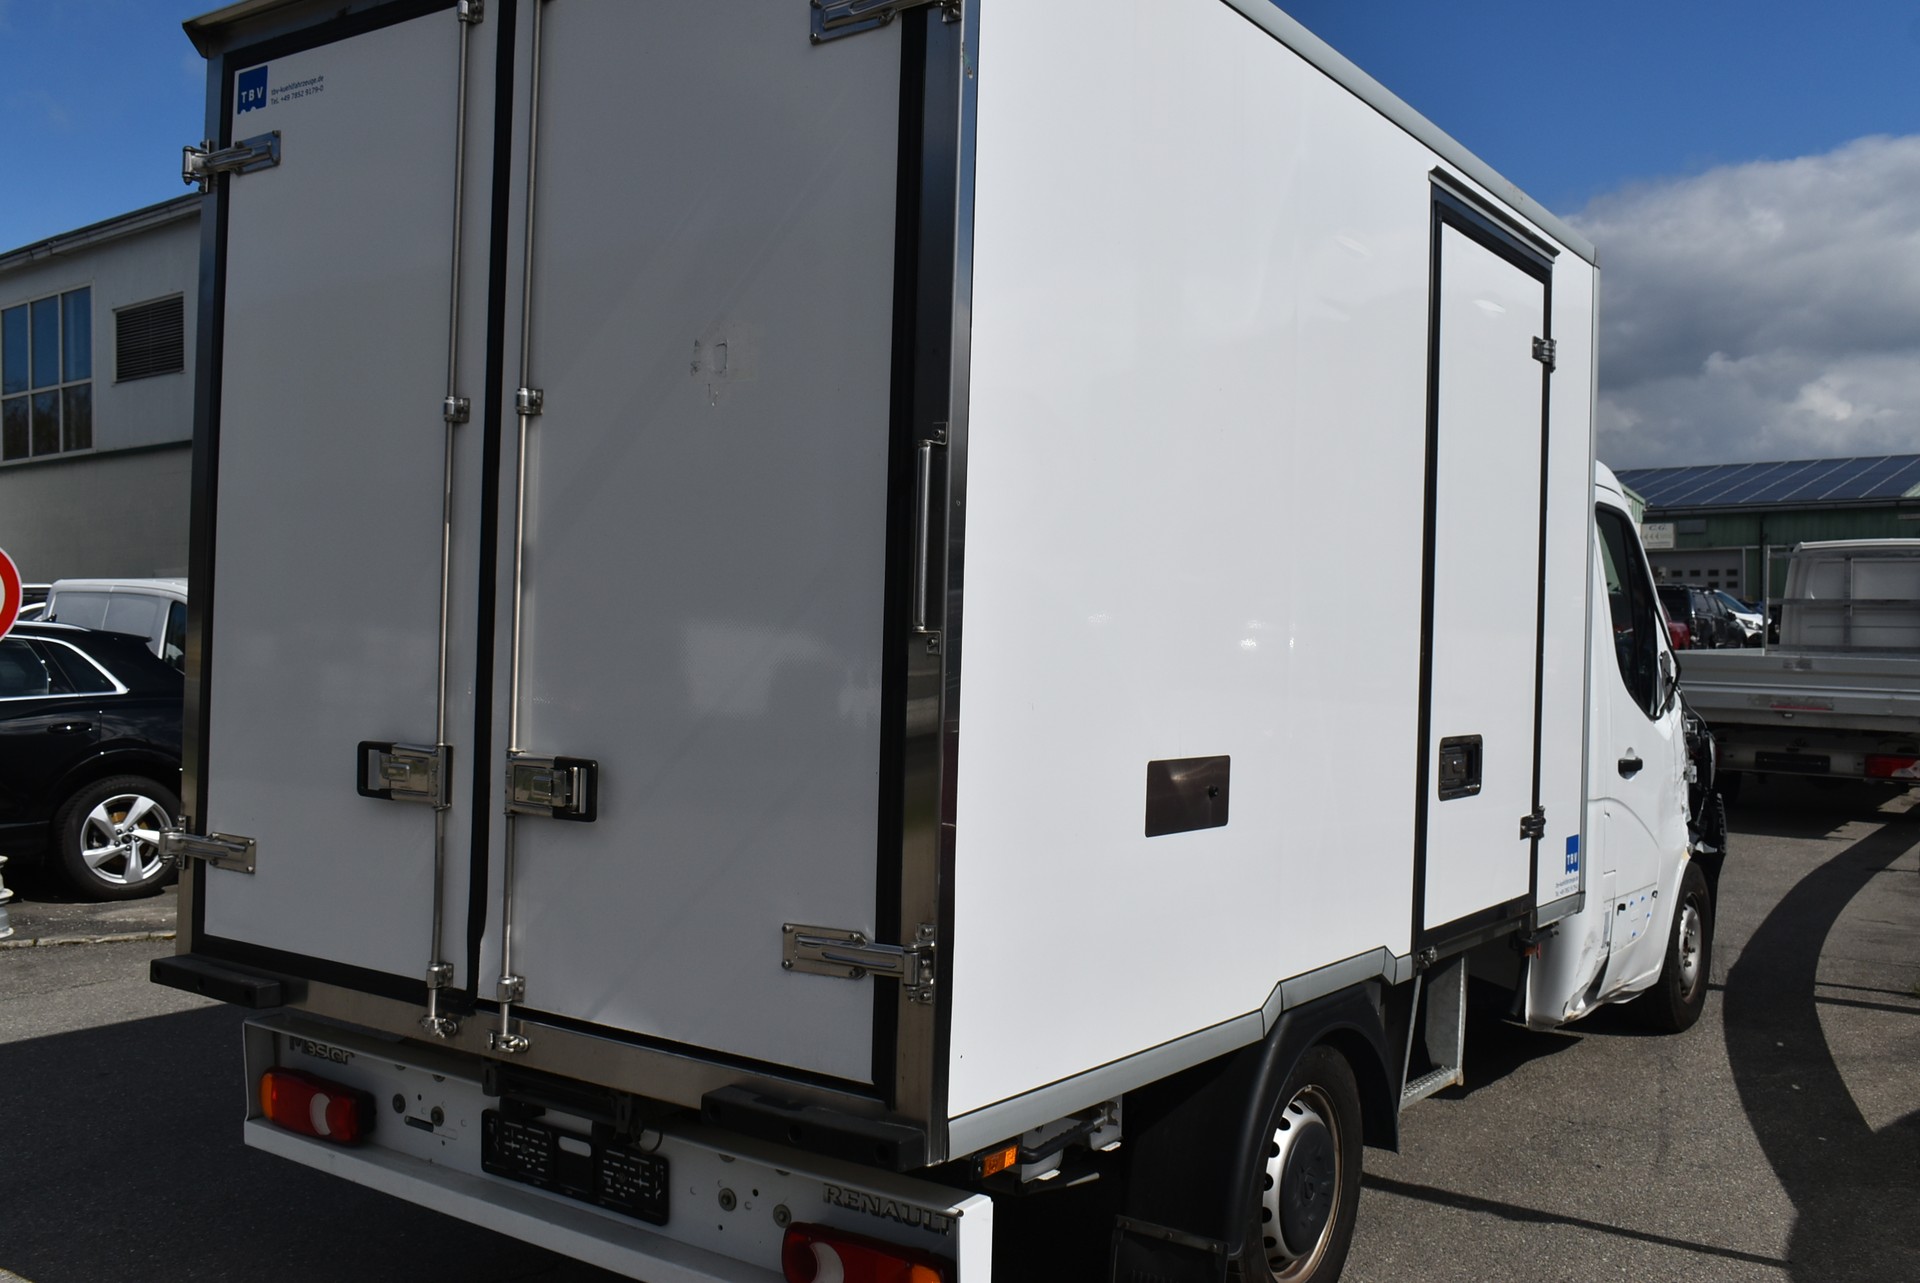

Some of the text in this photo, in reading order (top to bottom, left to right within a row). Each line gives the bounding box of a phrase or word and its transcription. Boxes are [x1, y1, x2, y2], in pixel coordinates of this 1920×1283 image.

[241, 86, 264, 104] TBV
[280, 94, 291, 102] +49
[823, 1182, 956, 1236] RENAULT
